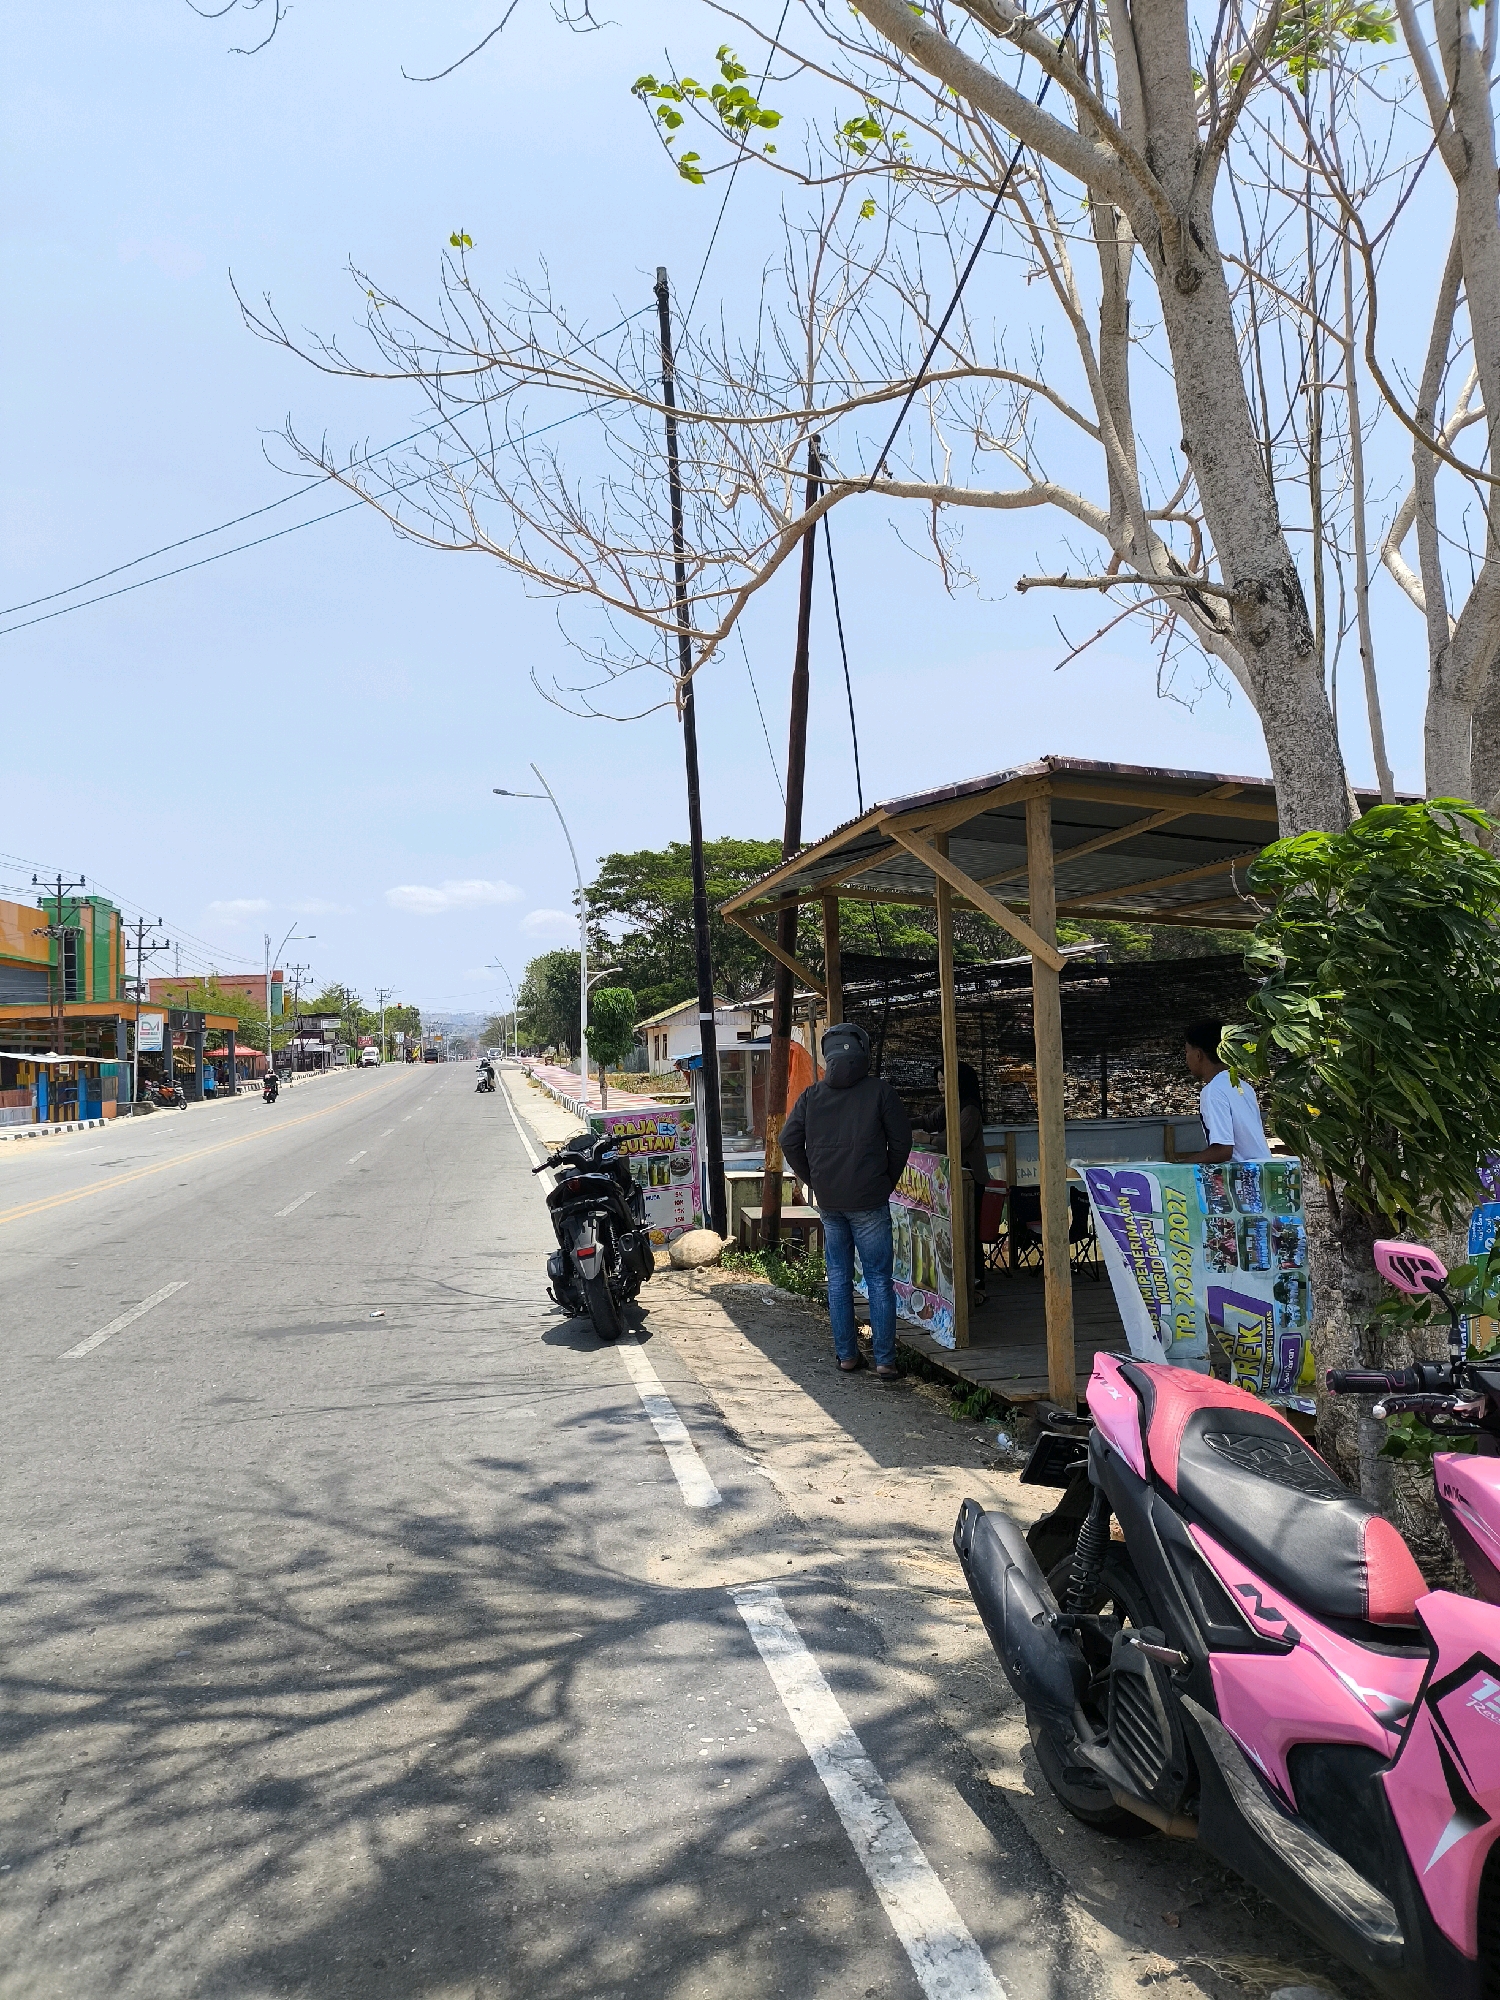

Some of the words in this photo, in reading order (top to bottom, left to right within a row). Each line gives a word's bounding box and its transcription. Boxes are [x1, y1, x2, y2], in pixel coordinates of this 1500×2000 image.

[612, 1119, 658, 1136] RAJA
[658, 1121, 677, 1136] ES
[618, 1136, 676, 1155] SULTAN
[1117, 1196, 1151, 1286] PENERIMAAN
[1139, 1218, 1160, 1257] BARU
[1164, 1186, 1196, 1307] 2026/2027
[1151, 1259, 1172, 1305] MURID
[1175, 1310, 1197, 1340] TP.
